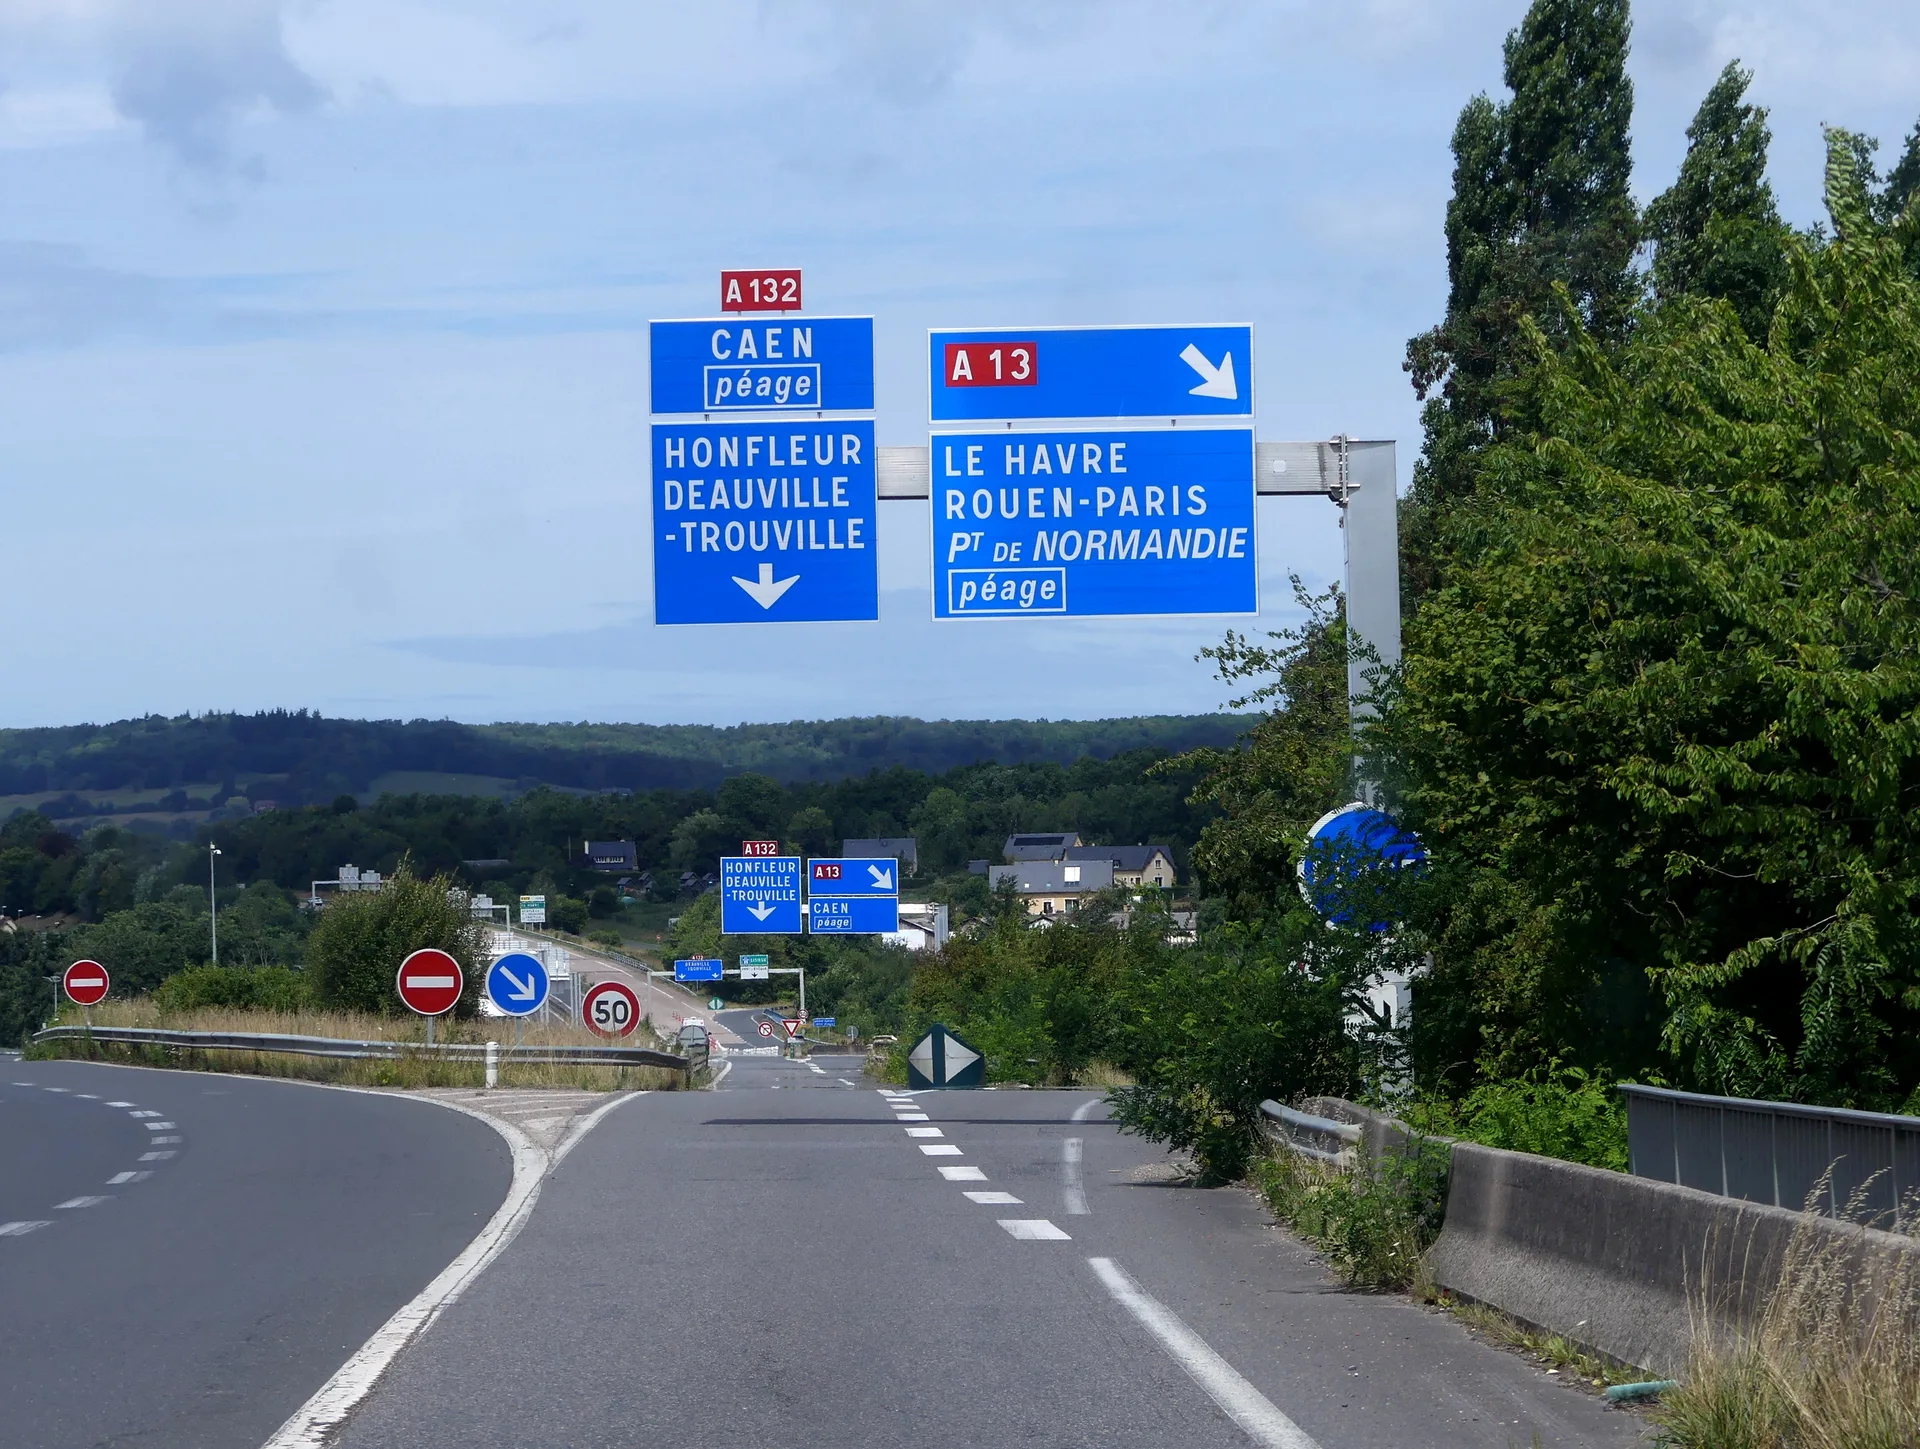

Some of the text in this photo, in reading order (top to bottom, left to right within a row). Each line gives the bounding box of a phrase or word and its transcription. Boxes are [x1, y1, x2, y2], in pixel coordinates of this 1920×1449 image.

[725, 277, 797, 303] A 132
[711, 327, 812, 360] CAEN
[952, 348, 1031, 381] A 13
[714, 370, 812, 404] péage
[665, 434, 862, 469] HONFLEUR
[945, 442, 1128, 477] LE HAVRE
[664, 476, 850, 511] DEAUVILLE
[946, 484, 1208, 520] ROUEN-PARIS
[665, 518, 866, 553] -TROUVILLE
[992, 542, 1023, 562] DE
[1031, 527, 1249, 562] NORMANDIE
[959, 574, 1056, 608] péage
[754, 843, 776, 855] 132
[725, 861, 796, 874] HONFLEUR
[726, 876, 791, 888] DEAUVILLE
[825, 866, 841, 878] 13
[726, 889, 796, 902] -TROUVILLE
[813, 903, 848, 914] CAEN
[817, 916, 849, 929] péage
[595, 1000, 628, 1024] 50
